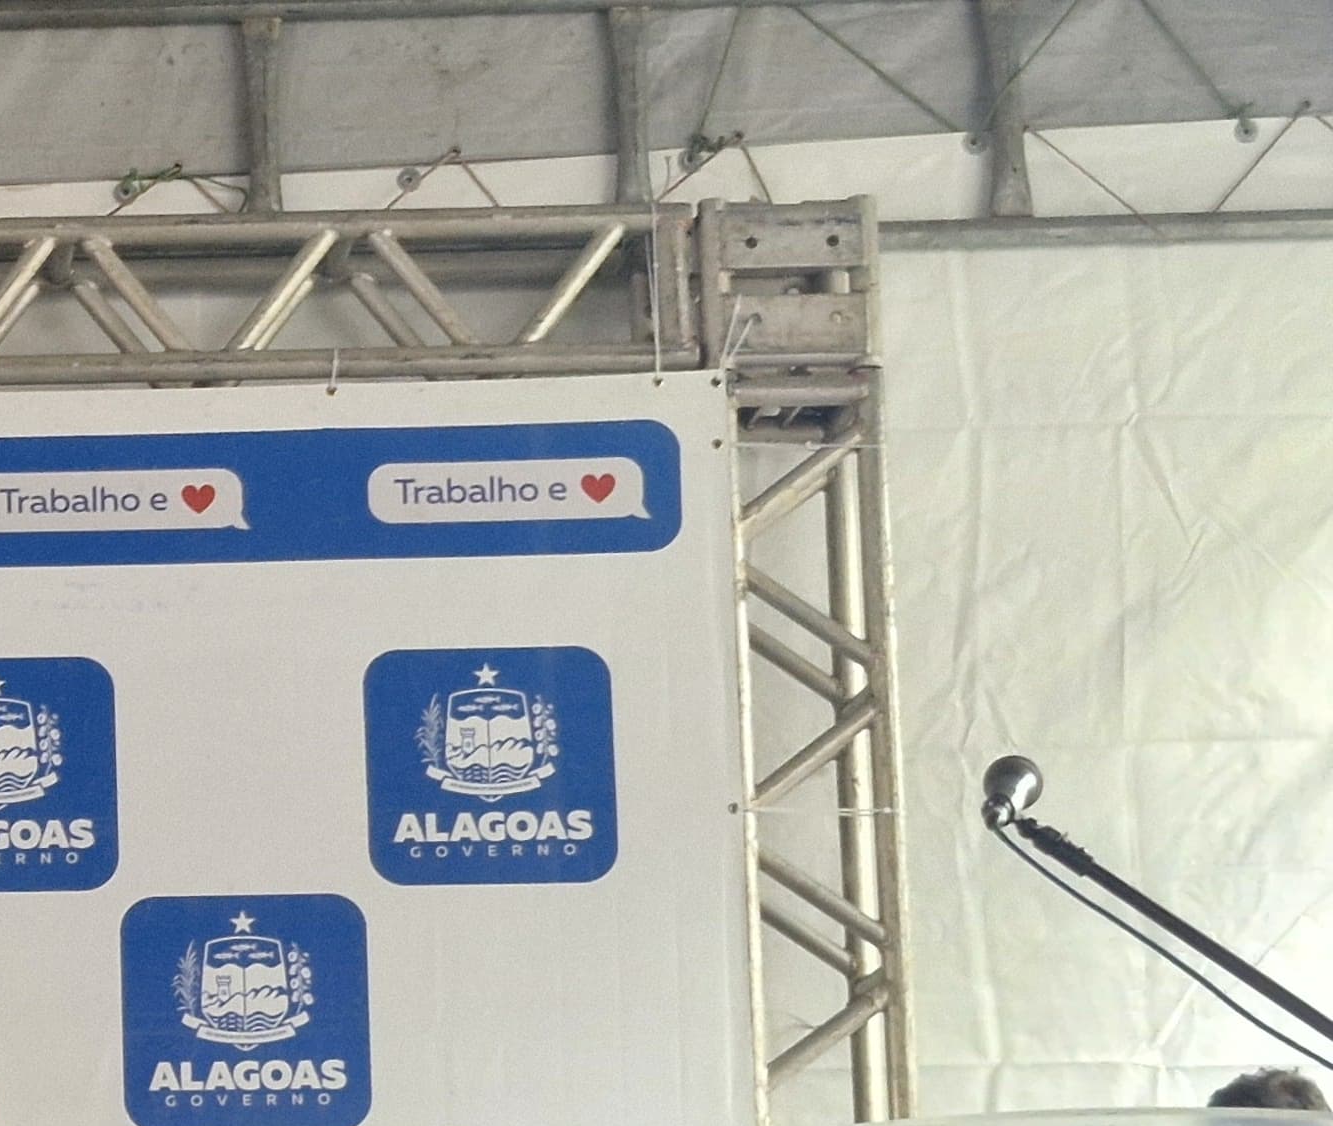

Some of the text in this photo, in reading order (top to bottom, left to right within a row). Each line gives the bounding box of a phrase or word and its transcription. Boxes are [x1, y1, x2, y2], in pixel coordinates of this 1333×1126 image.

[0, 487, 167, 513] Trabalho e
[394, 476, 567, 504] Trabalho e
[393, 810, 593, 842] ALAGOAS
[410, 844, 578, 858] GOVERNO
[149, 1059, 347, 1091] ALAGOAS
[165, 1093, 331, 1107] GOVERNO
